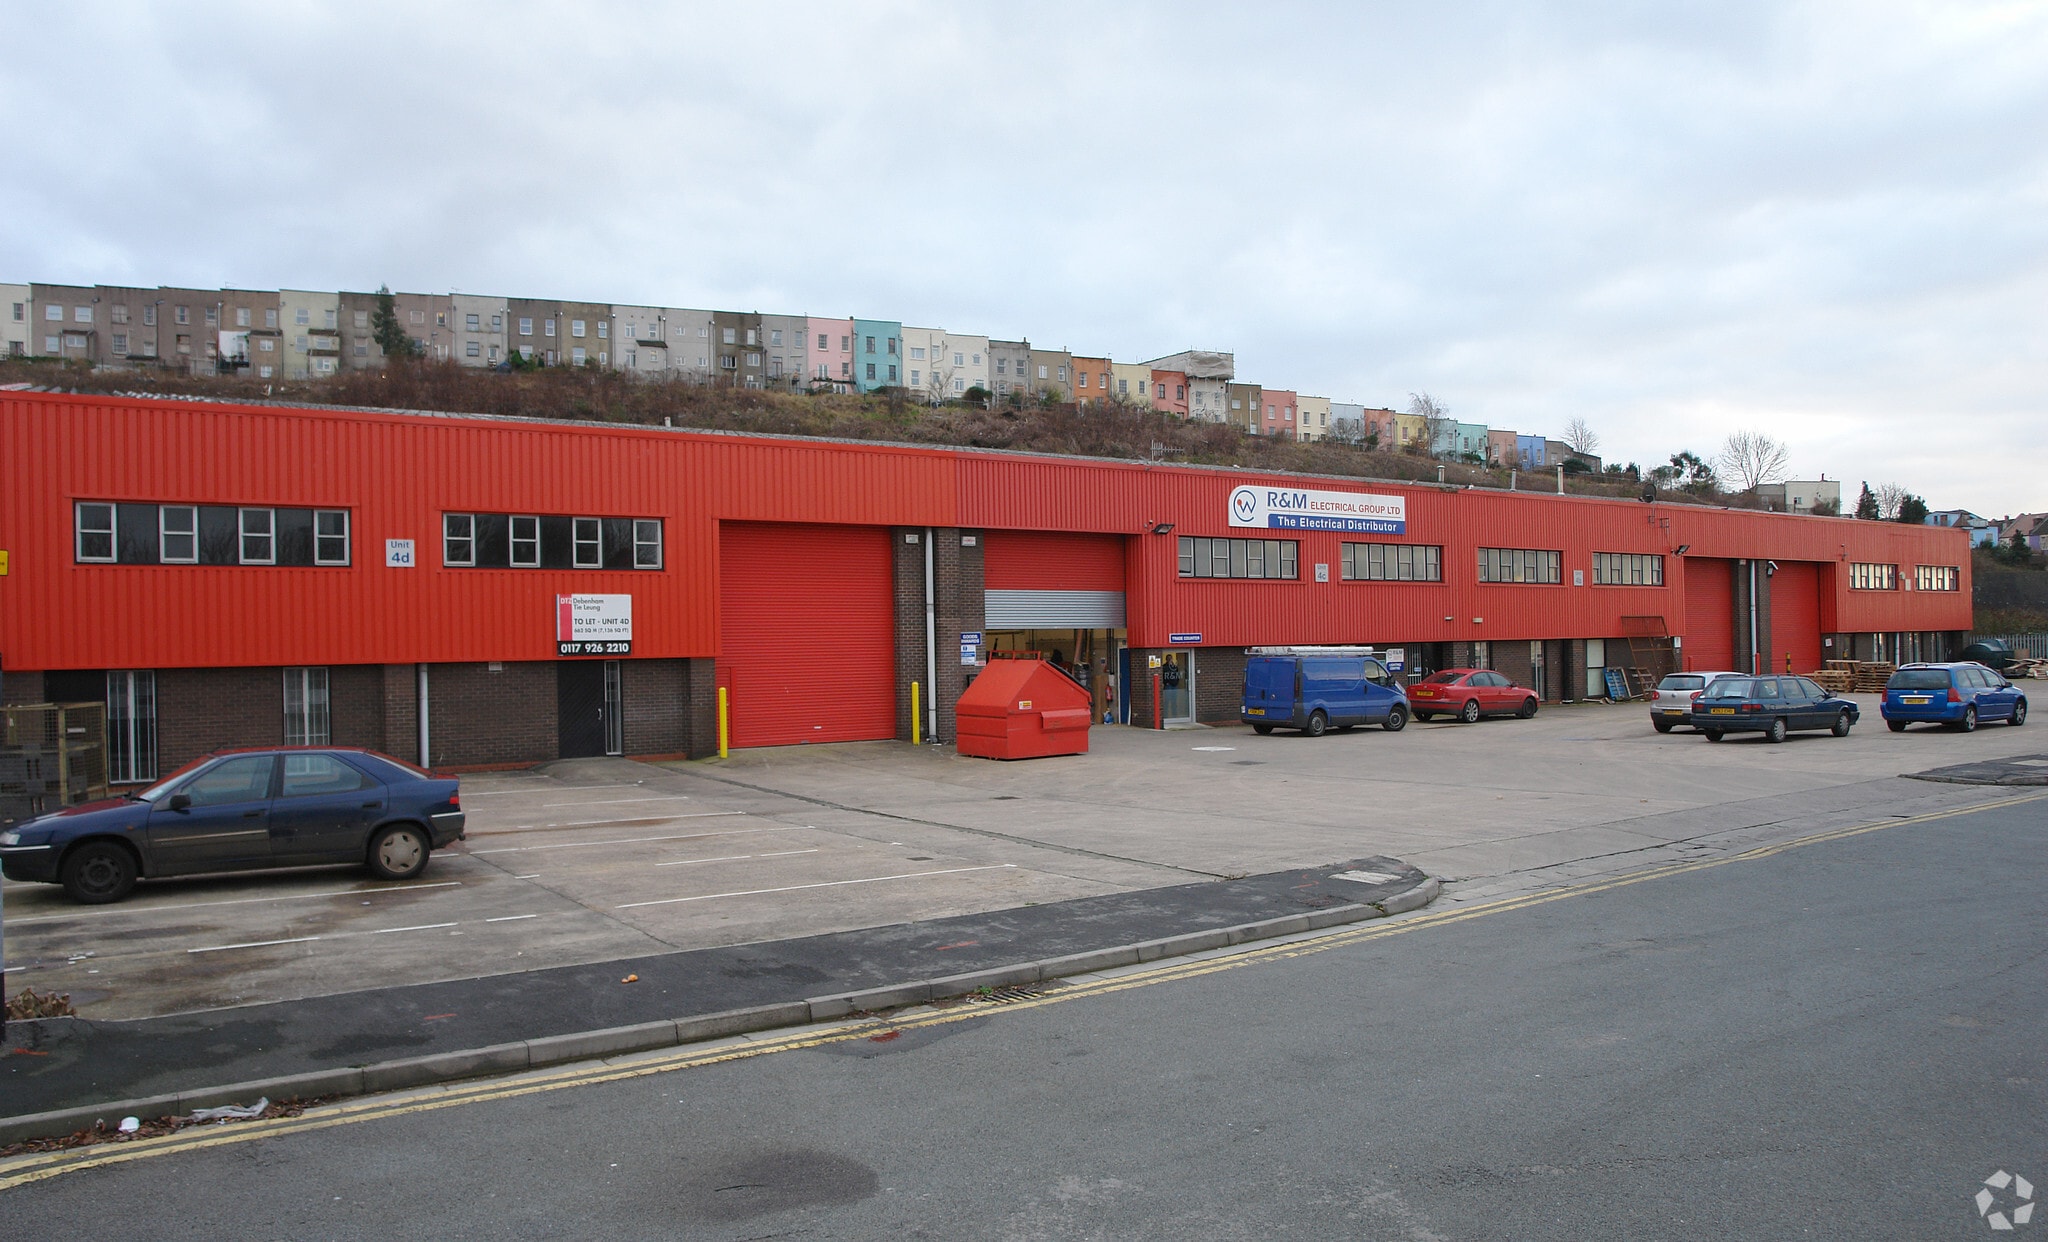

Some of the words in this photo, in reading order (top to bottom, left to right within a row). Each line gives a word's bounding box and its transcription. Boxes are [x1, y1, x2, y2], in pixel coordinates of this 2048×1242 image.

[1267, 491, 1307, 509] R&M
[1310, 501, 1357, 513] ELECTRICAL
[1358, 504, 1386, 514] GROUP
[1387, 506, 1401, 515] LTD
[1277, 516, 1296, 526] The
[1300, 518, 1346, 529] Electrical
[1348, 520, 1397, 532] Distributor
[390, 541, 409, 549] Unit
[391, 552, 410, 563] 4d
[560, 597, 572, 605] DTZ
[584, 604, 601, 612] Leung
[560, 643, 581, 653] 0117
[584, 643, 603, 653] 926
[606, 643, 629, 653] 2210
[1164, 672, 1184, 680] R&M
